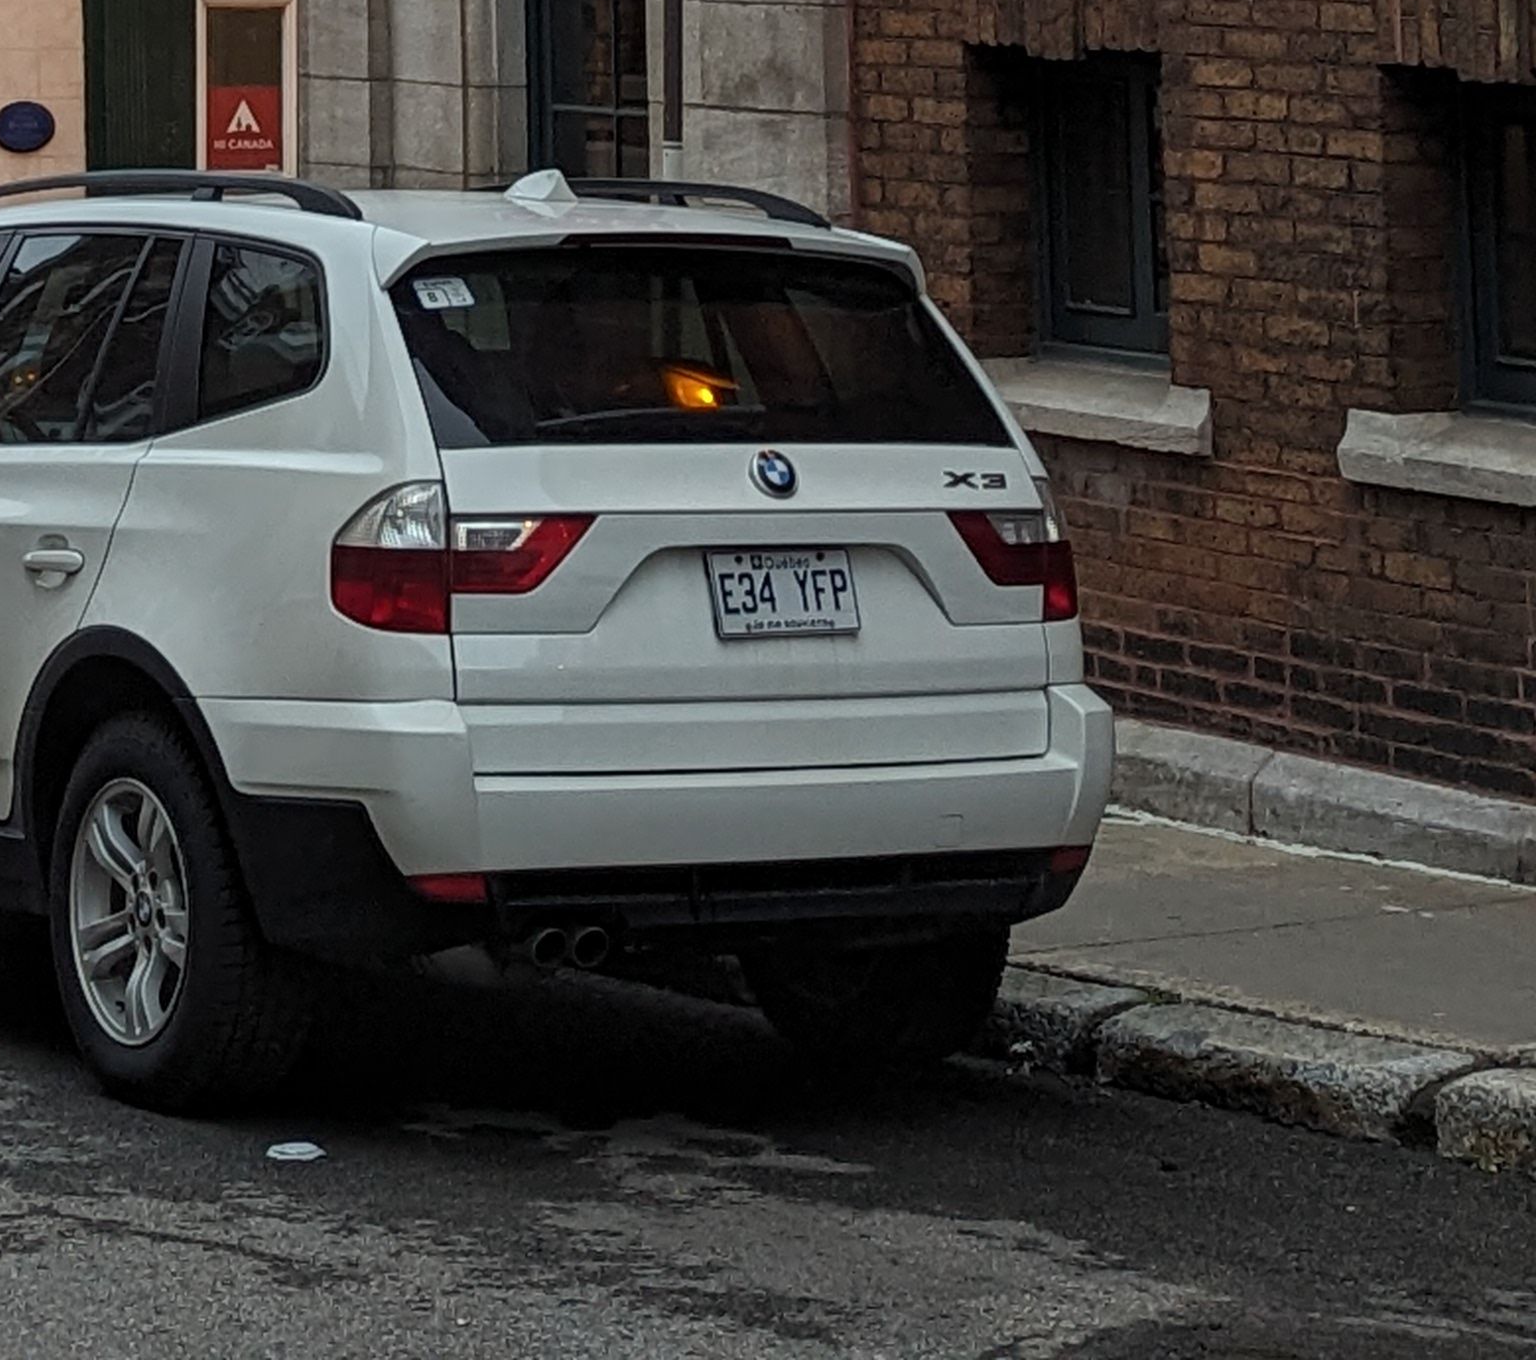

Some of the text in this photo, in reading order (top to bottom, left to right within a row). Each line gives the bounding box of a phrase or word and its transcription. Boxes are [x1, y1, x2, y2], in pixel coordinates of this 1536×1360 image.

[228, 139, 274, 150] CANADA
[942, 470, 1008, 490] X3
[718, 568, 848, 615] E34 YFP
